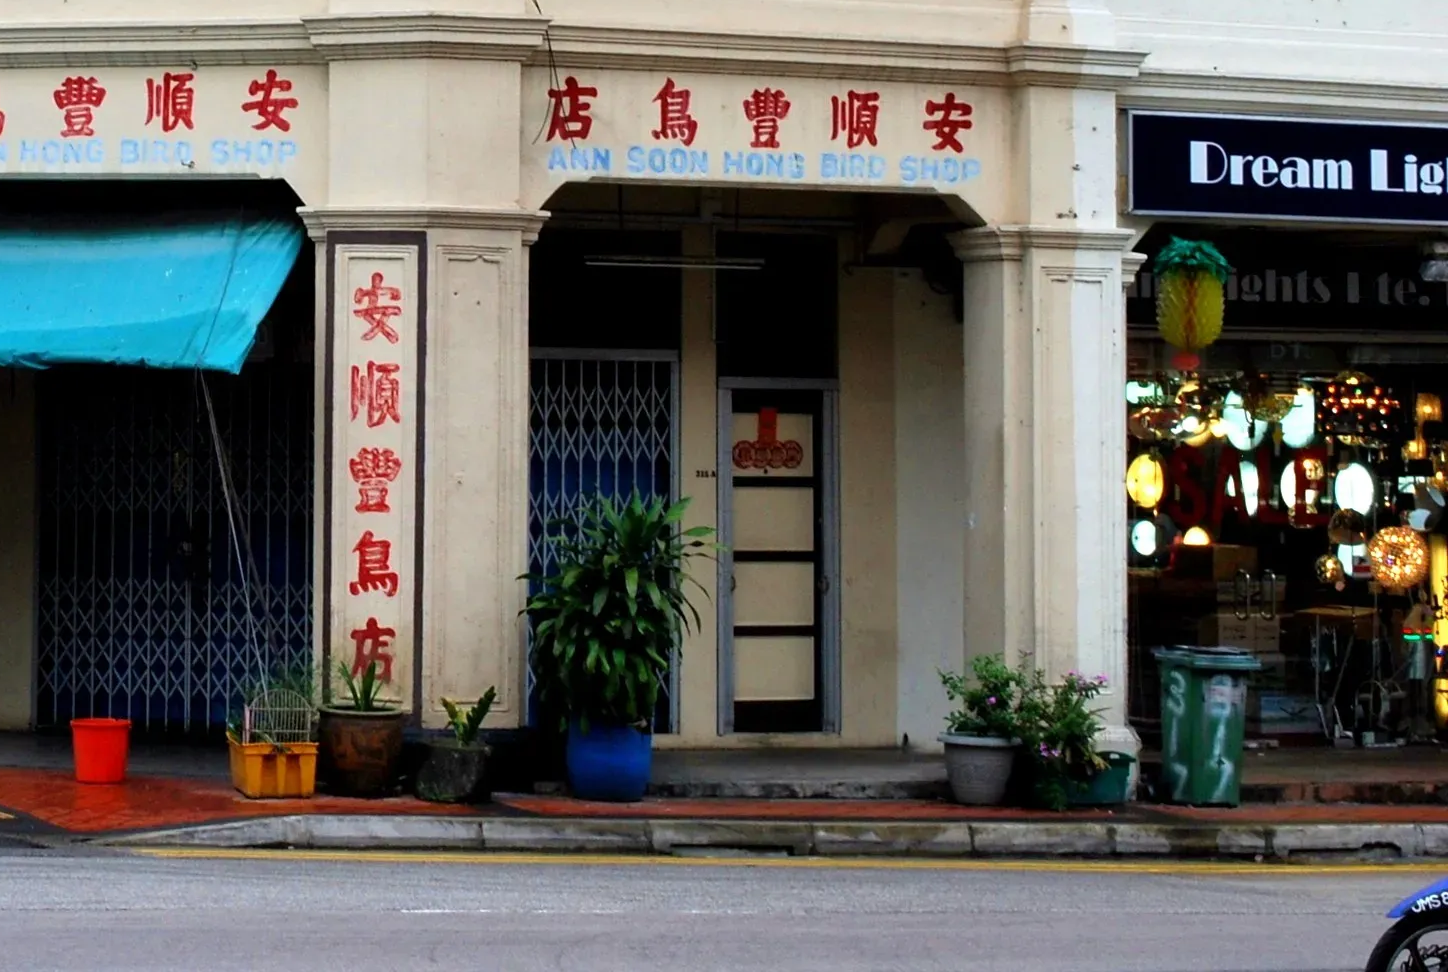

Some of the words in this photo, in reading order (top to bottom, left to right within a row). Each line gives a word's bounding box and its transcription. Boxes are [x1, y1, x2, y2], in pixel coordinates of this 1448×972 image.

[20, 139, 104, 165] HONG
[211, 139, 297, 166] SHOP
[547, 145, 612, 172] ANN
[626, 145, 709, 175] SOON
[723, 149, 806, 180] HONG
[820, 152, 887, 180] BIRD
[900, 154, 982, 184] SHOP
[1189, 140, 1353, 190] Dream
[1370, 148, 1448, 196] Lig
[1226, 267, 1332, 305] ights
[1411, 893, 1442, 913] JMS
